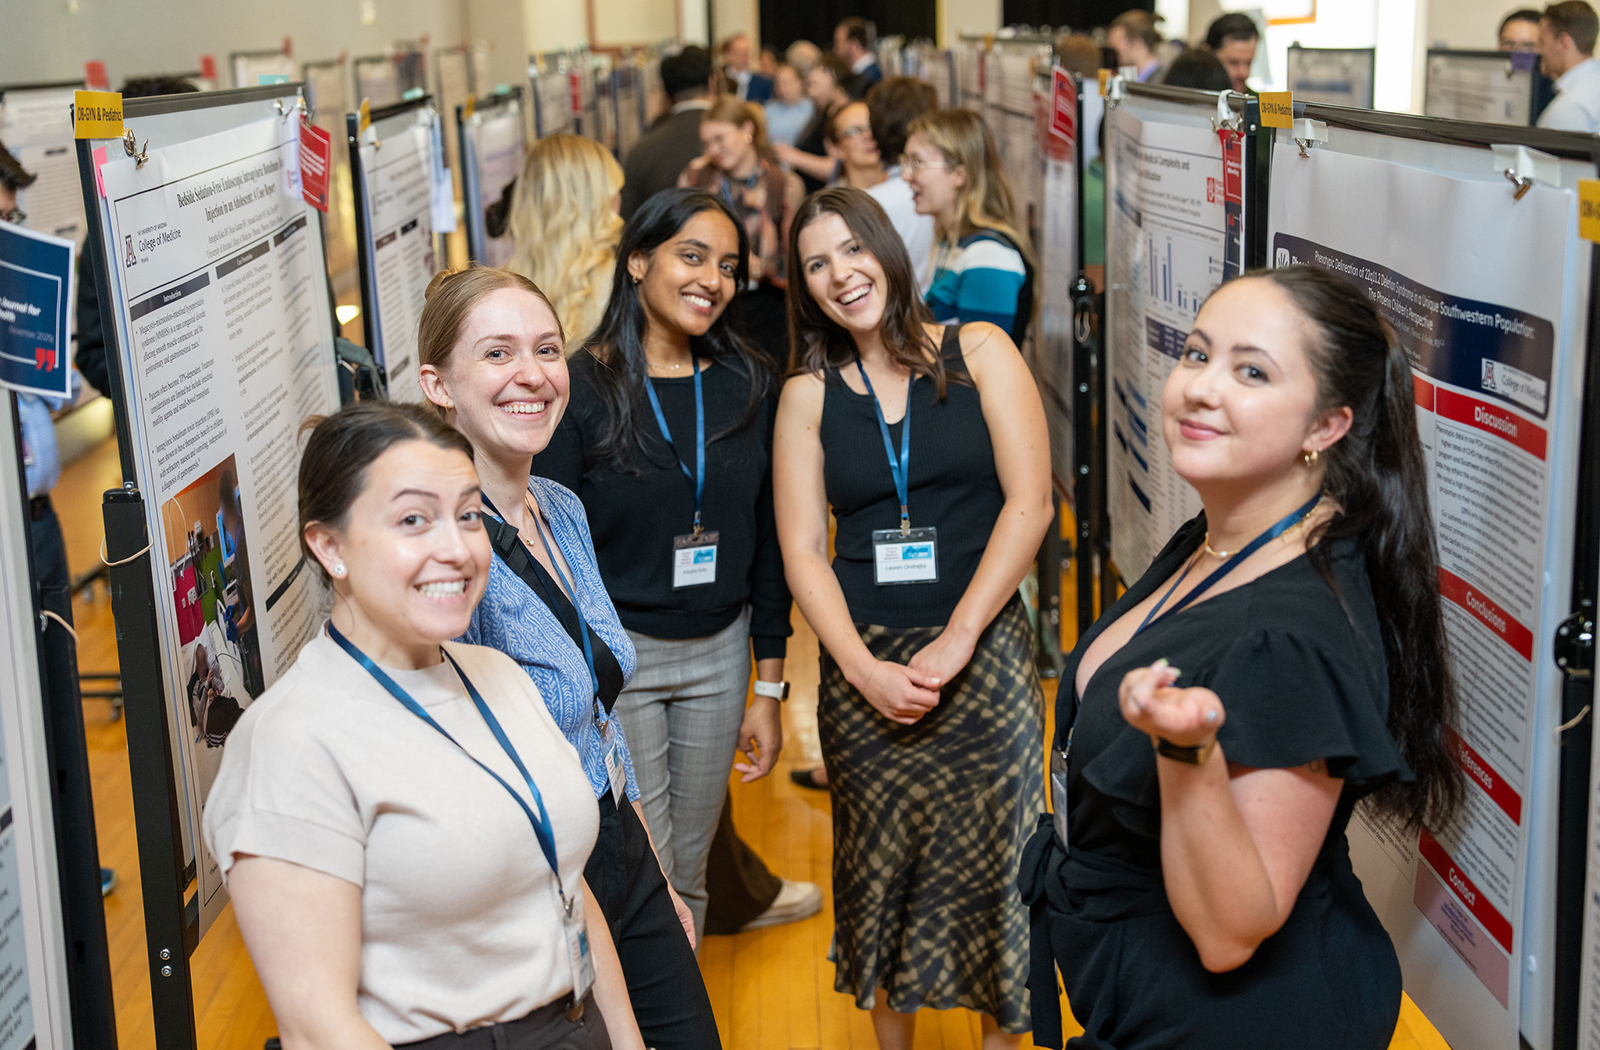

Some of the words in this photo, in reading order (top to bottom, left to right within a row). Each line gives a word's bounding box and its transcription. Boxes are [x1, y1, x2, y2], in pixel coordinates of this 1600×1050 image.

[78, 107, 96, 121] OB-GYN
[97, 107, 101, 121] &
[102, 107, 122, 121] Pediatrics
[1262, 102, 1274, 114] OB-GYN
[1274, 102, 1277, 114] &
[1278, 104, 1292, 116] Pediatrics
[1160, 156, 1180, 172] Complexity
[1181, 160, 1190, 170] and
[176, 190, 195, 208] Bedside
[194, 181, 222, 202] Sedation-Free
[222, 172, 243, 194] Endoscopic
[204, 204, 223, 223] Injection
[223, 201, 228, 214] in
[228, 201, 234, 212] an
[256, 186, 264, 200] Case
[264, 183, 276, 198] Report
[139, 238, 156, 252] College
[156, 234, 162, 245] of
[162, 229, 181, 244] Medicine
[163, 290, 182, 302] Introduction
[1315, 250, 1335, 270] Phenotypic
[1335, 258, 1358, 277] Delineation
[1358, 268, 1365, 279] of
[1364, 268, 1381, 285] 22q11.2
[1381, 274, 1396, 291] Deletion
[1396, 281, 1414, 301] Syndrome
[1414, 288, 1418, 303] in
[1421, 293, 1439, 315] Unique
[1440, 301, 1494, 328] Southwestern
[28, 304, 41, 317] for
[1368, 287, 1376, 301] The
[1376, 290, 1392, 309] Phoenix
[1392, 298, 1409, 318] Children's
[1408, 307, 1434, 331] Perspective
[142, 337, 155, 350] syndrome
[182, 314, 196, 328] congenital
[196, 310, 206, 320] disorder
[144, 349, 156, 362] affecting
[156, 342, 166, 354] smooth
[166, 337, 177, 348] muscle
[149, 390, 160, 401] Patients
[160, 384, 168, 394] often
[168, 379, 179, 390] become
[201, 358, 214, 370] Treatment
[150, 398, 171, 414] considerations
[176, 386, 186, 399] limited
[191, 380, 201, 390] include
[201, 371, 213, 384] intestinal
[1501, 374, 1518, 392] College
[163, 410, 173, 421] agents
[195, 414, 207, 429] injection
[1474, 406, 1518, 438] Discussion
[1466, 590, 1507, 634] Conclusions
[1448, 867, 1476, 906] Contact
